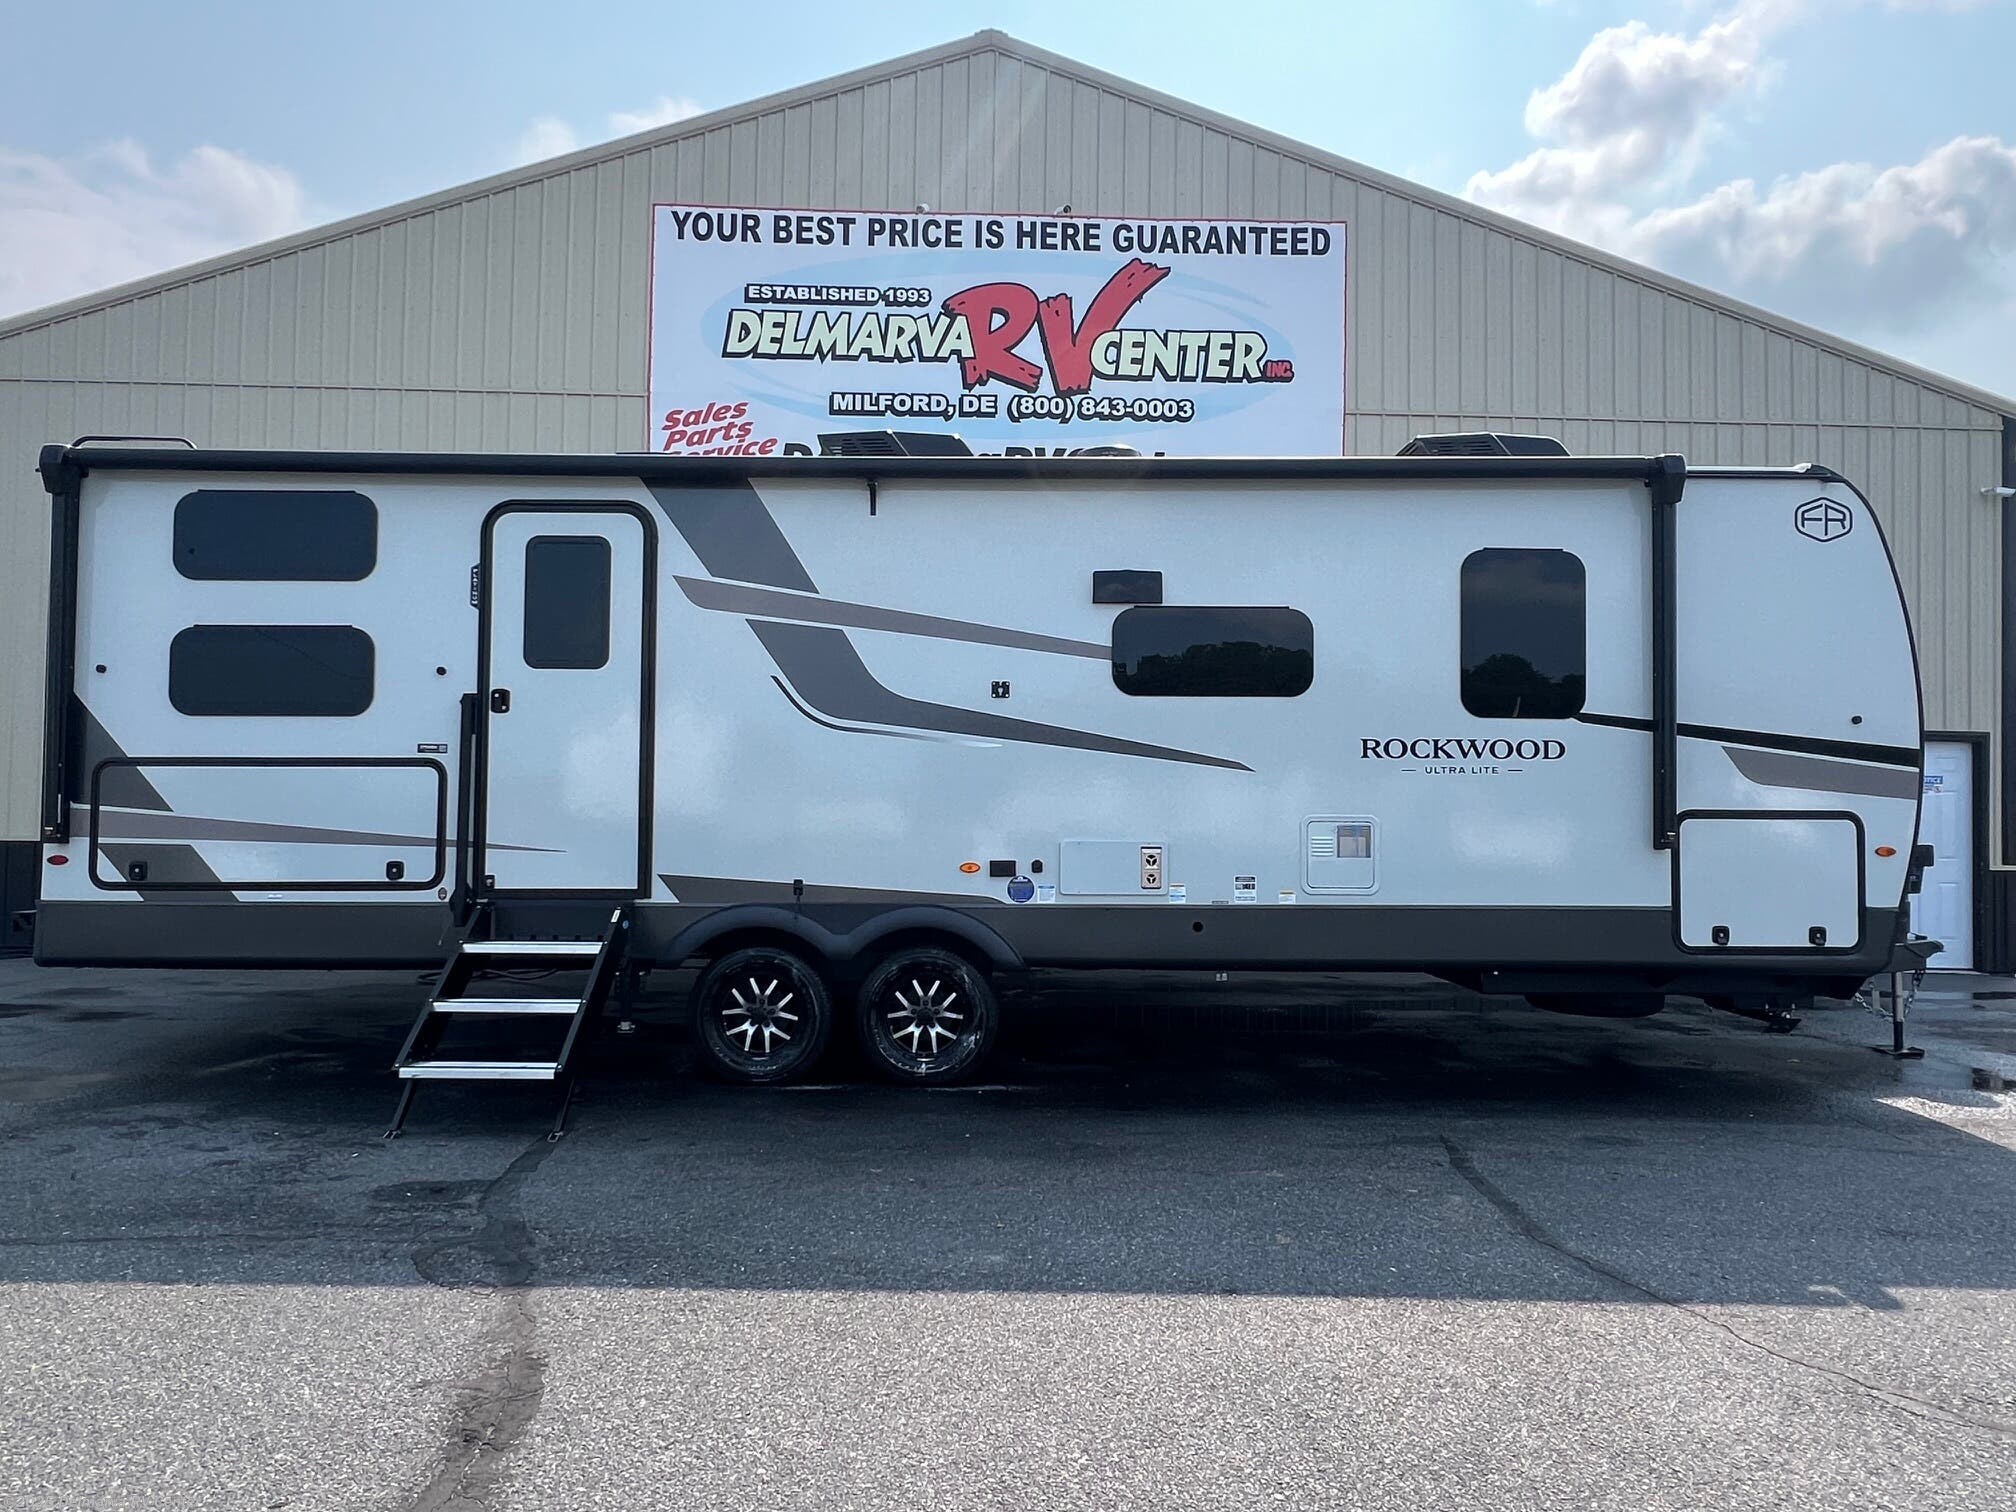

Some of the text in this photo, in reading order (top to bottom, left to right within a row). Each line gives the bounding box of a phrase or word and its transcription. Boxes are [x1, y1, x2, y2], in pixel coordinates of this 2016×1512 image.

[671, 211, 1331, 256] YOUR BEST PRICE IS HERE GUARANTEED
[745, 285, 931, 305] ESTABLISHED 1993
[722, 309, 976, 363] DELMARVA
[942, 258, 1171, 396] RV
[1090, 329, 1269, 381] CENTER
[662, 402, 748, 431] Sales
[831, 393, 1195, 421] MILFORD, DE (800) 843-0003
[663, 421, 754, 451] Parts
[1360, 738, 1567, 760] ROCKWOOD
[1424, 766, 1500, 775] ULTRA LITE
